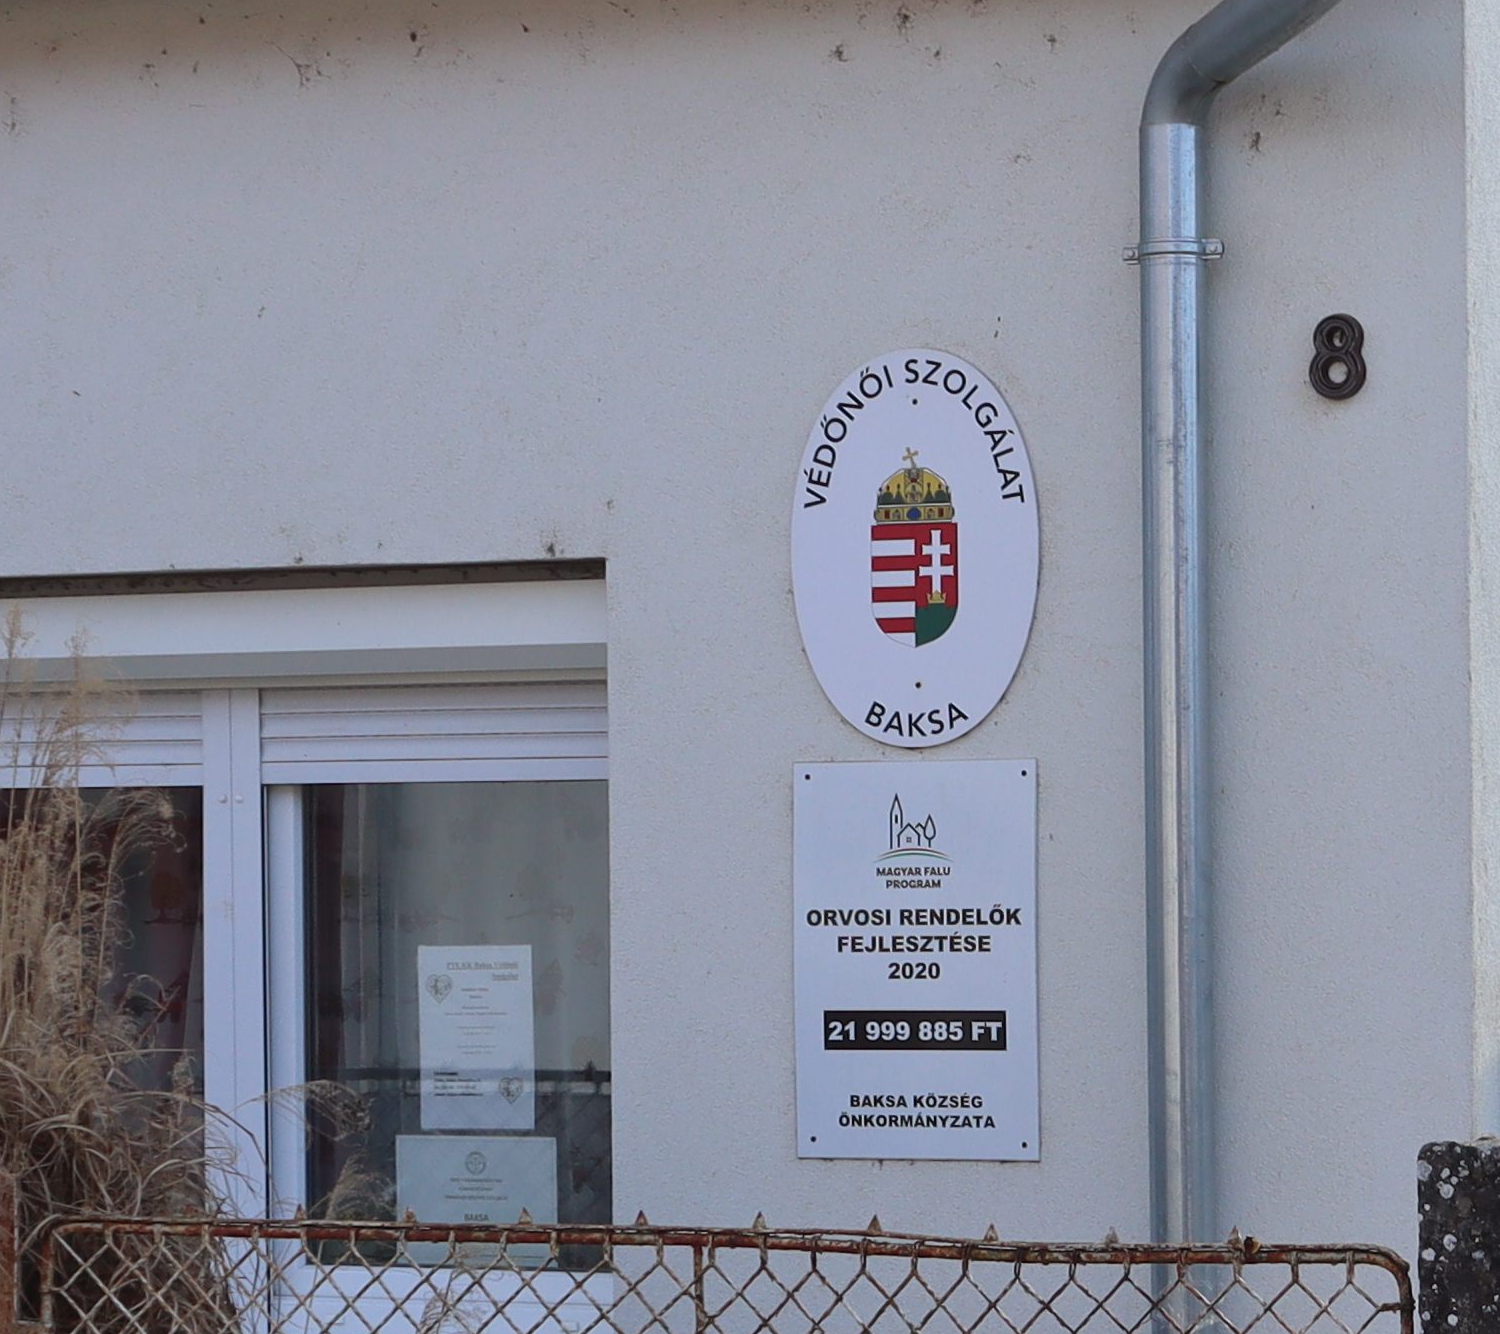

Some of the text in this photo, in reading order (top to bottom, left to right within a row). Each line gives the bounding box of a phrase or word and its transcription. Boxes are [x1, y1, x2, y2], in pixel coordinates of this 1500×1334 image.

[1308, 313, 1367, 401] 8
[803, 359, 1025, 509] VÉDŐNŐI SZOLGÁLAT
[864, 701, 969, 737] BAKSA
[876, 866, 951, 877] MAGYAR FALU
[885, 879, 941, 889] PROGRAM
[806, 903, 1022, 927] ORVOSI RENDELŐK
[837, 931, 991, 953] FEJLESZTÉSE
[888, 962, 941, 980] 2020
[828, 1021, 1003, 1041] 21 999 885 FT
[849, 1091, 983, 1109] BAKSA KÖZSÉG
[838, 1110, 996, 1129] ÖNKORMÁNYZATA
